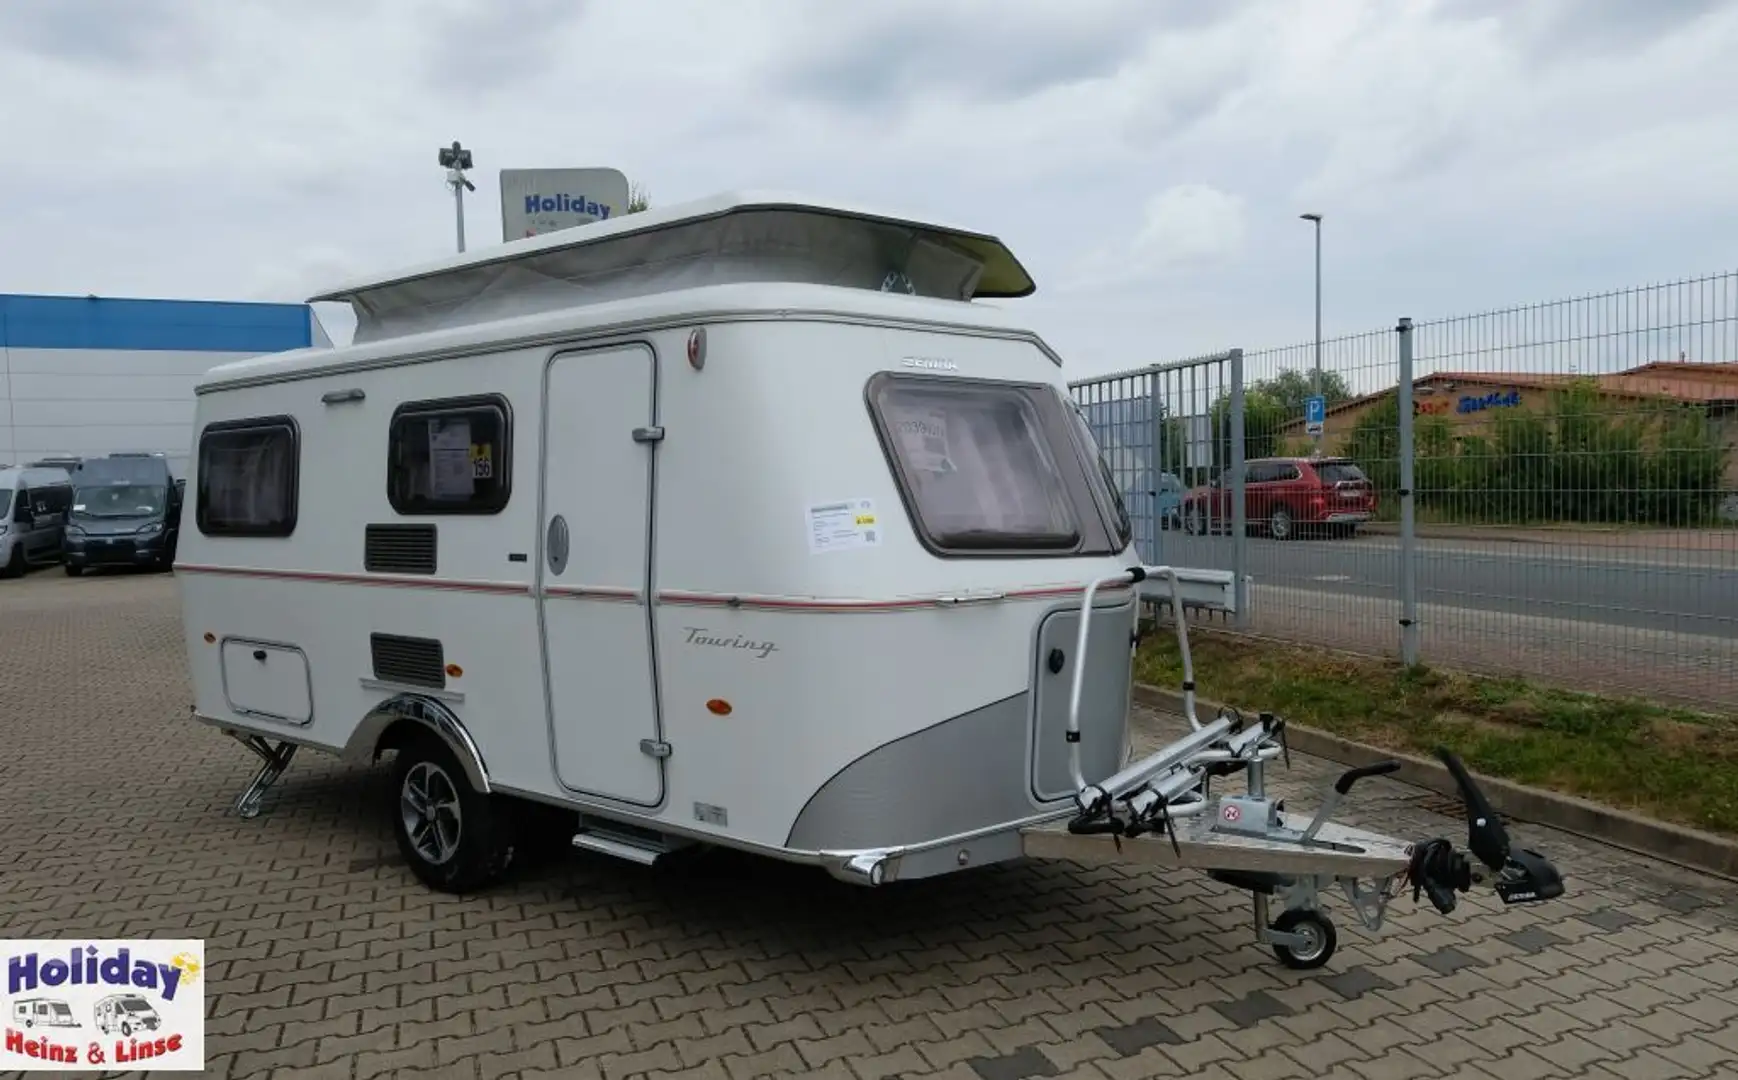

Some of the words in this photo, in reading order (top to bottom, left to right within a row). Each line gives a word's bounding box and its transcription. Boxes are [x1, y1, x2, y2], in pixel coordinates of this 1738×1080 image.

[524, 193, 611, 220] Holiday
[1309, 400, 1321, 421] P
[681, 626, 780, 659] Touring
